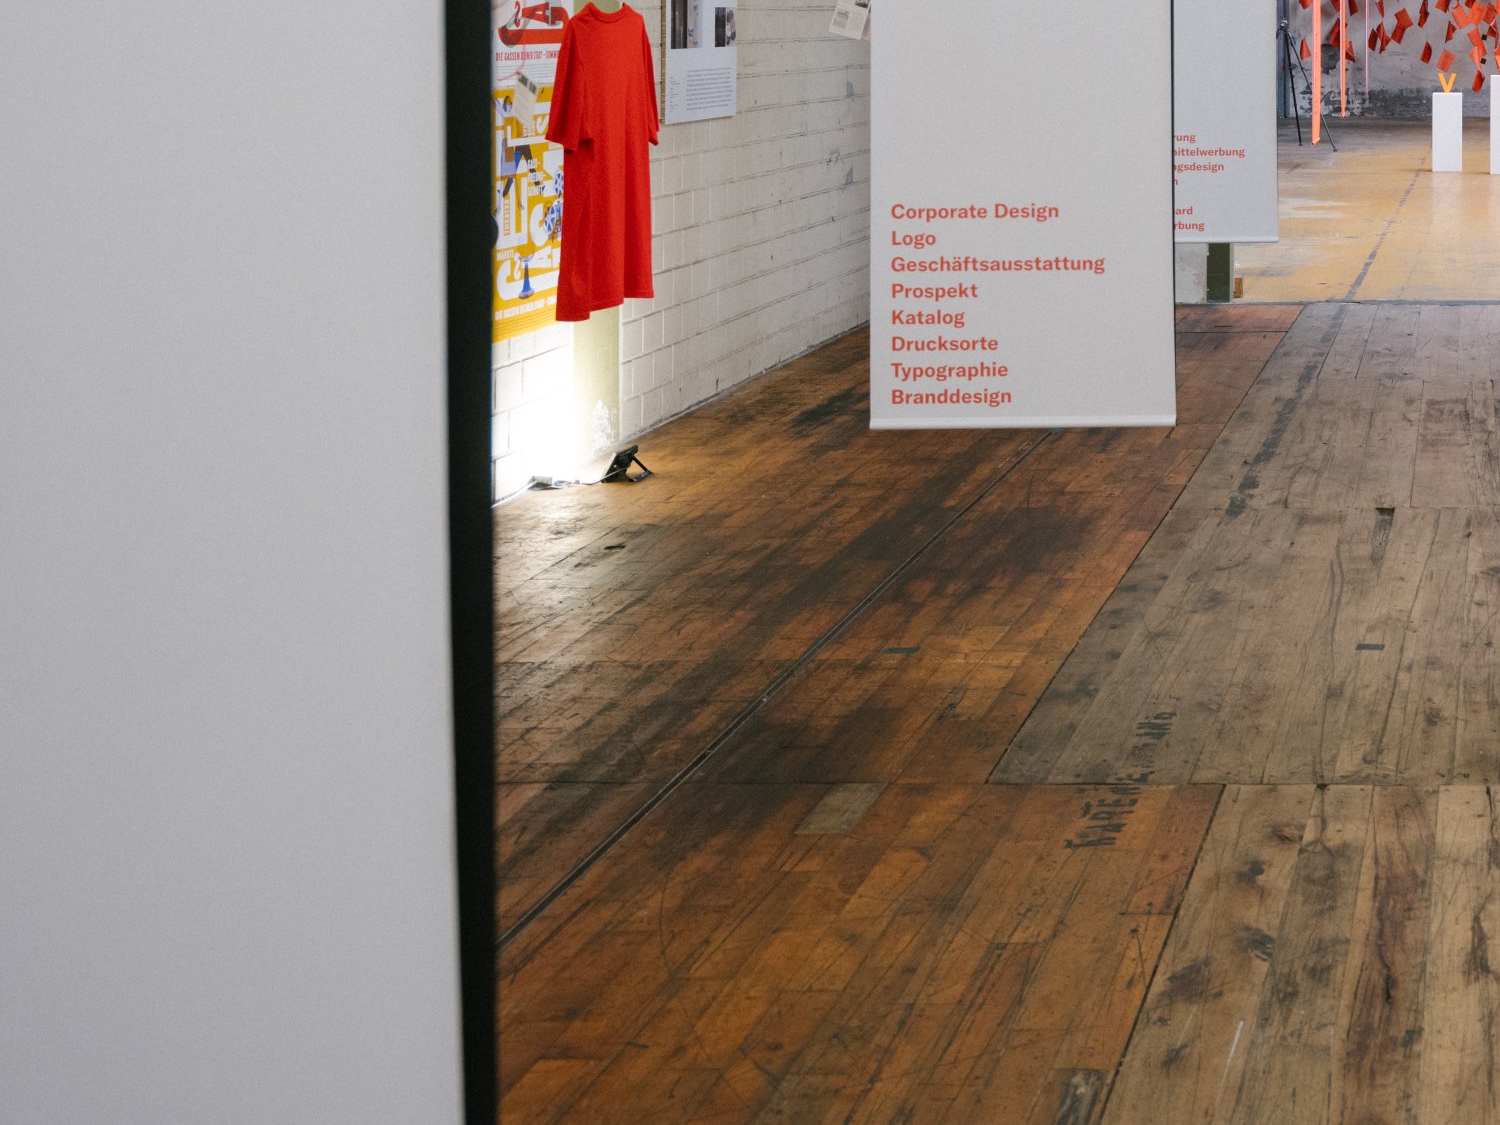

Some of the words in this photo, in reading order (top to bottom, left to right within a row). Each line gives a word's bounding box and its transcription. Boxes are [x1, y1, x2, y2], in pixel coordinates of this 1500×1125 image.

[891, 203, 987, 223] Corporate
[994, 203, 1059, 222] Design
[892, 231, 936, 249] Logo
[891, 256, 1105, 274] Geschäftsausstattung
[891, 283, 978, 301] Prospekt
[891, 309, 965, 328] Katalog
[891, 335, 999, 352] Drucksorte
[891, 361, 1009, 382] Typographie
[891, 388, 1012, 407] Branddesign
